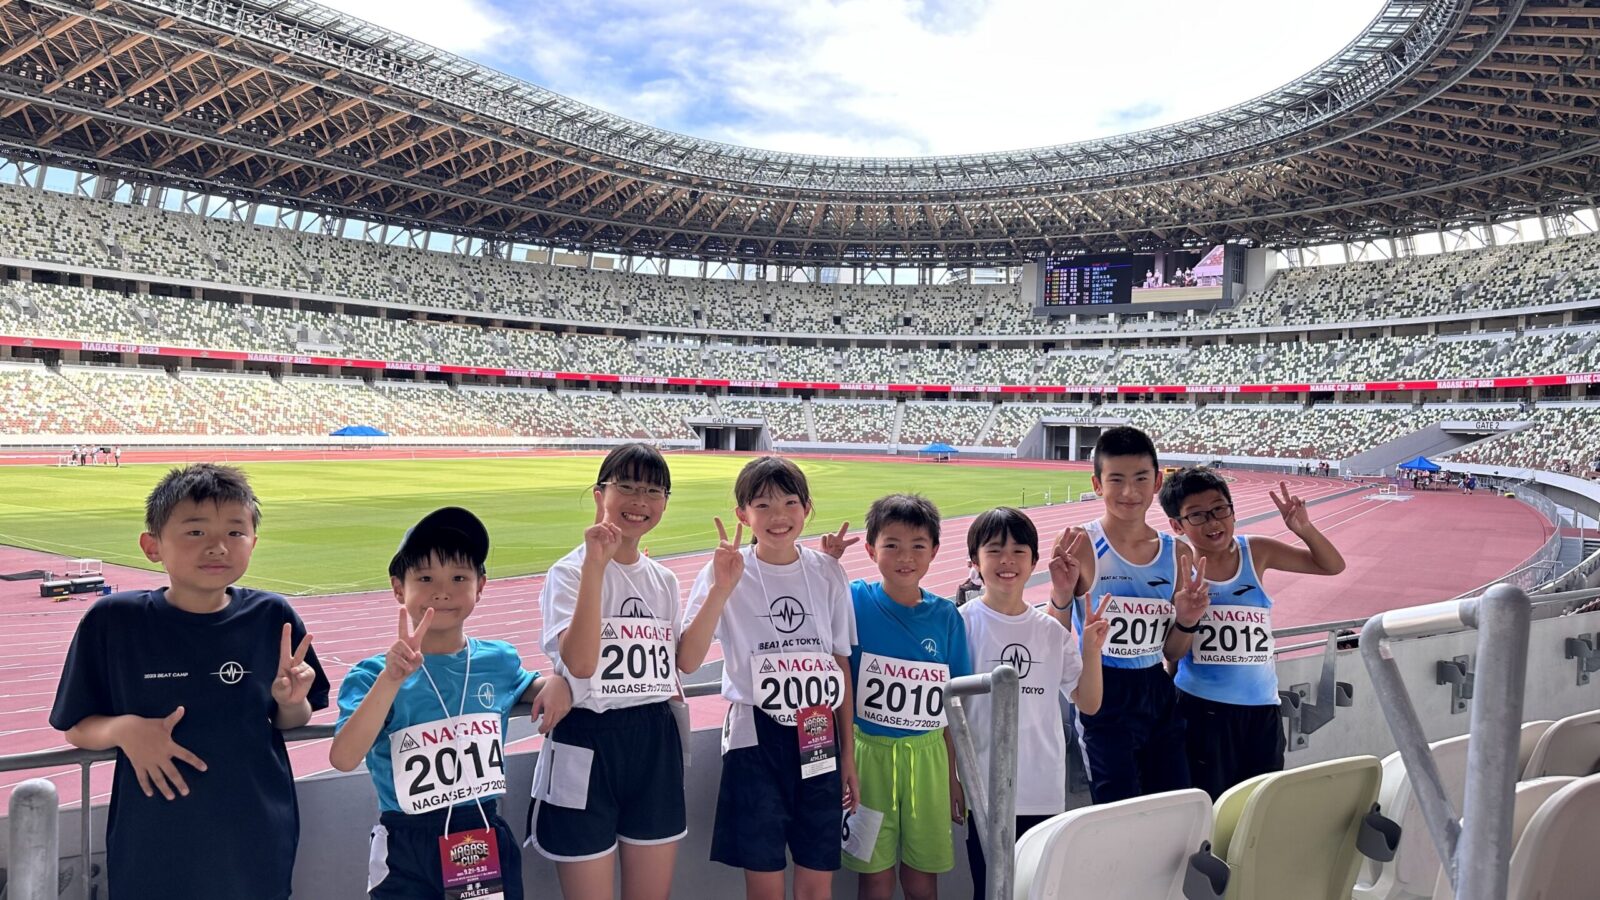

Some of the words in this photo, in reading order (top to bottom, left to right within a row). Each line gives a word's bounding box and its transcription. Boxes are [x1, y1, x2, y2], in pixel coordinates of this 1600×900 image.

[81, 342, 118, 352] NAGASE
[120, 344, 136, 352] CUP
[248, 353, 278, 362] NAGASE
[1566, 375, 1592, 384] NAGASE
[1124, 602, 1175, 615] NAGASE
[1213, 610, 1266, 624] NAGASE
[621, 625, 672, 641] NAGASE
[1110, 616, 1171, 645] 2011
[1199, 624, 1268, 652] 2012
[758, 641, 779, 650] BEAT
[601, 644, 670, 680] 2013
[884, 663, 946, 682] NAGASE
[761, 676, 840, 710] 2009
[864, 678, 944, 716] 2010
[864, 710, 940, 727] NAGASEカップ2023
[422, 720, 500, 746] NAGASE
[405, 739, 505, 796] 2014
[450, 843, 489, 862] NAGASE
[461, 854, 480, 866] CUP
[460, 888, 489, 899] ATHLETE
